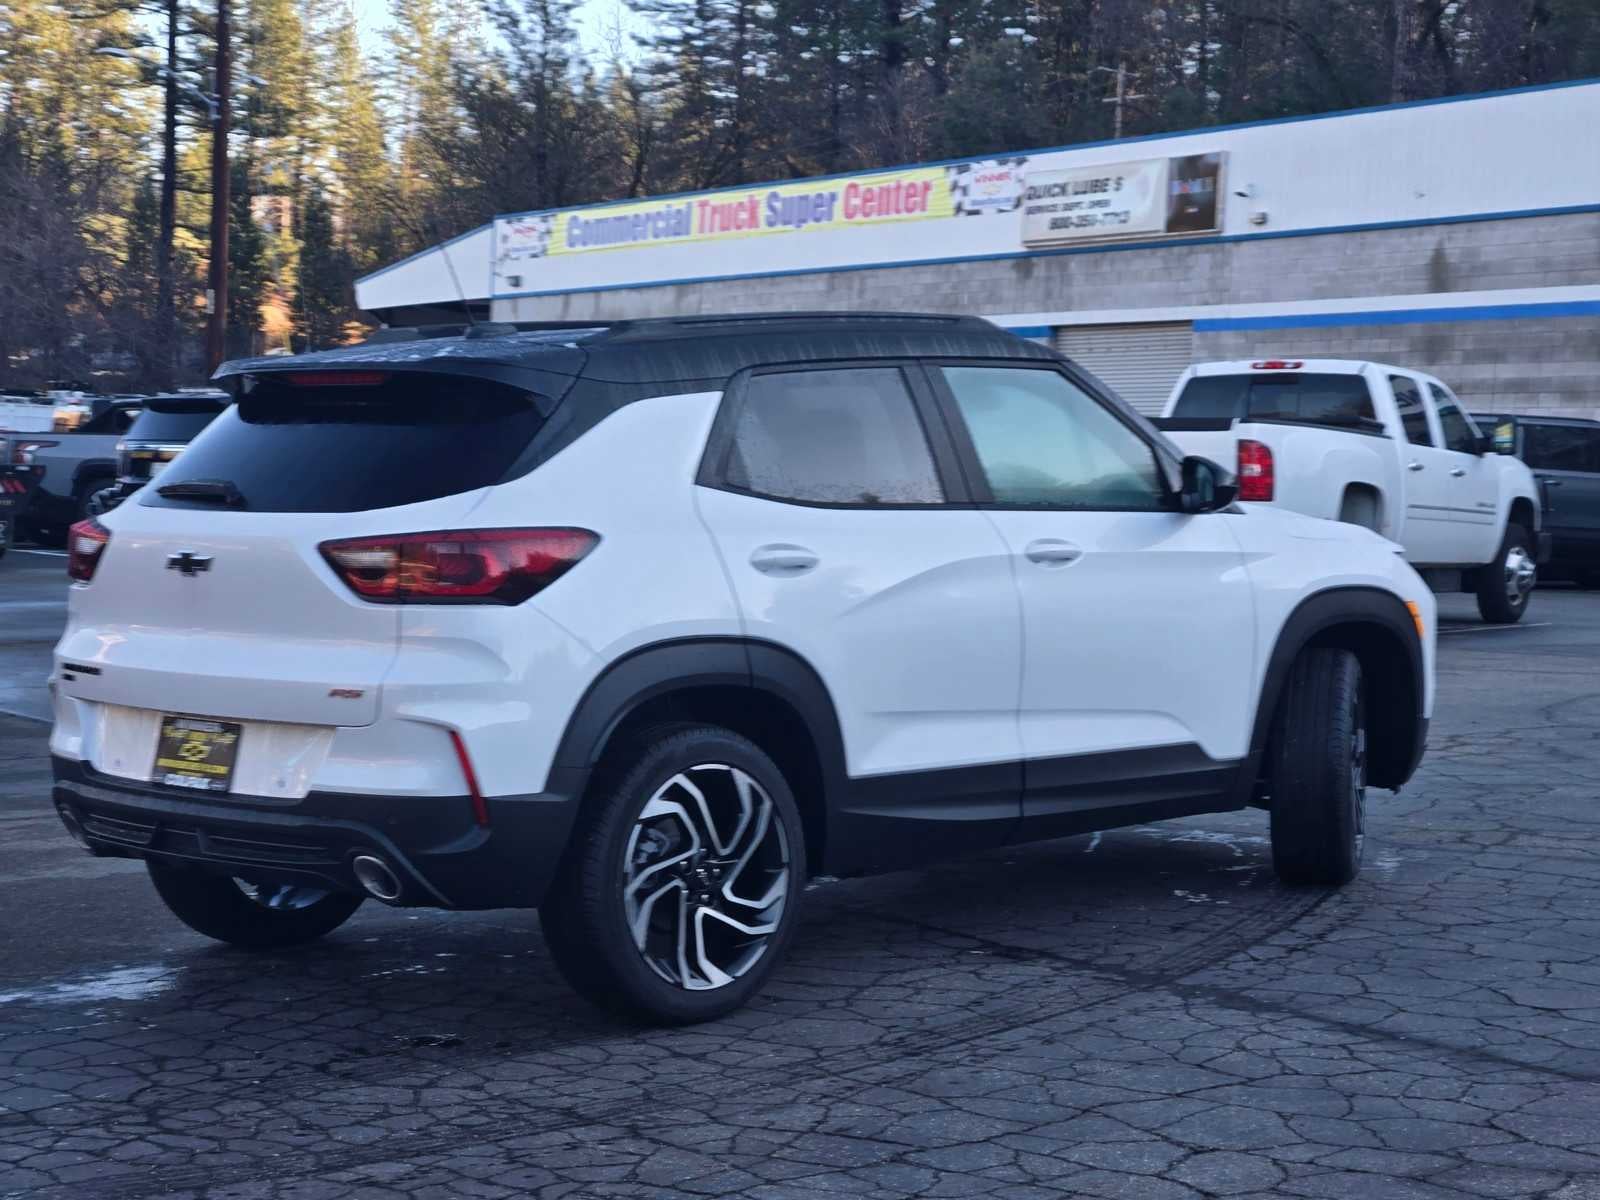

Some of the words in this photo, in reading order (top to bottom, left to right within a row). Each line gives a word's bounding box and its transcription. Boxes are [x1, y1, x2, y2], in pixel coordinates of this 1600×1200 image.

[1024, 181, 1066, 200] QUICK
[566, 200, 693, 248] Commercial
[696, 194, 761, 234] Truck
[765, 189, 838, 229] Super
[841, 179, 933, 220] Center
